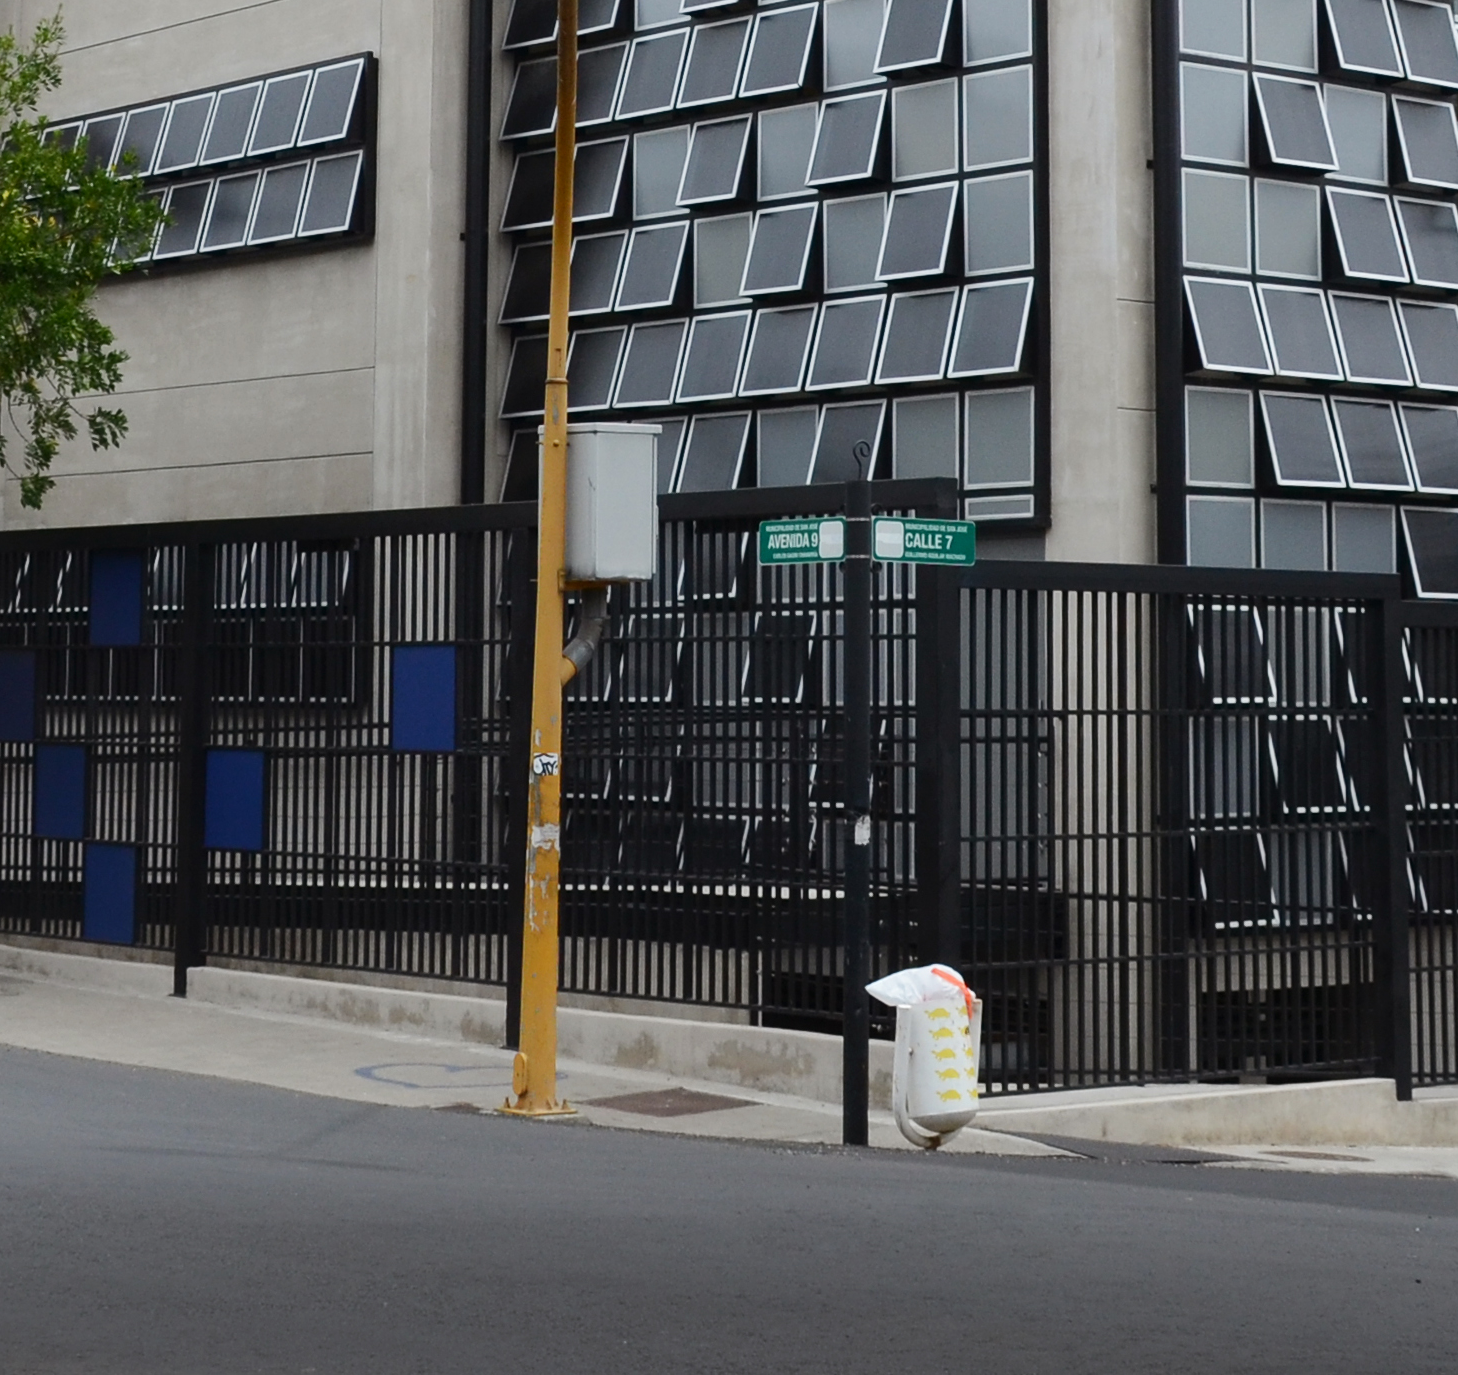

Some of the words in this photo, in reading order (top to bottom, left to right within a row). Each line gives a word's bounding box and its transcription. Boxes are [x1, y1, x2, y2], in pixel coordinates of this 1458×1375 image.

[768, 532, 810, 550] AVENIDA
[811, 532, 819, 548] 9
[905, 532, 943, 550] CALLE
[945, 535, 954, 550] 7
